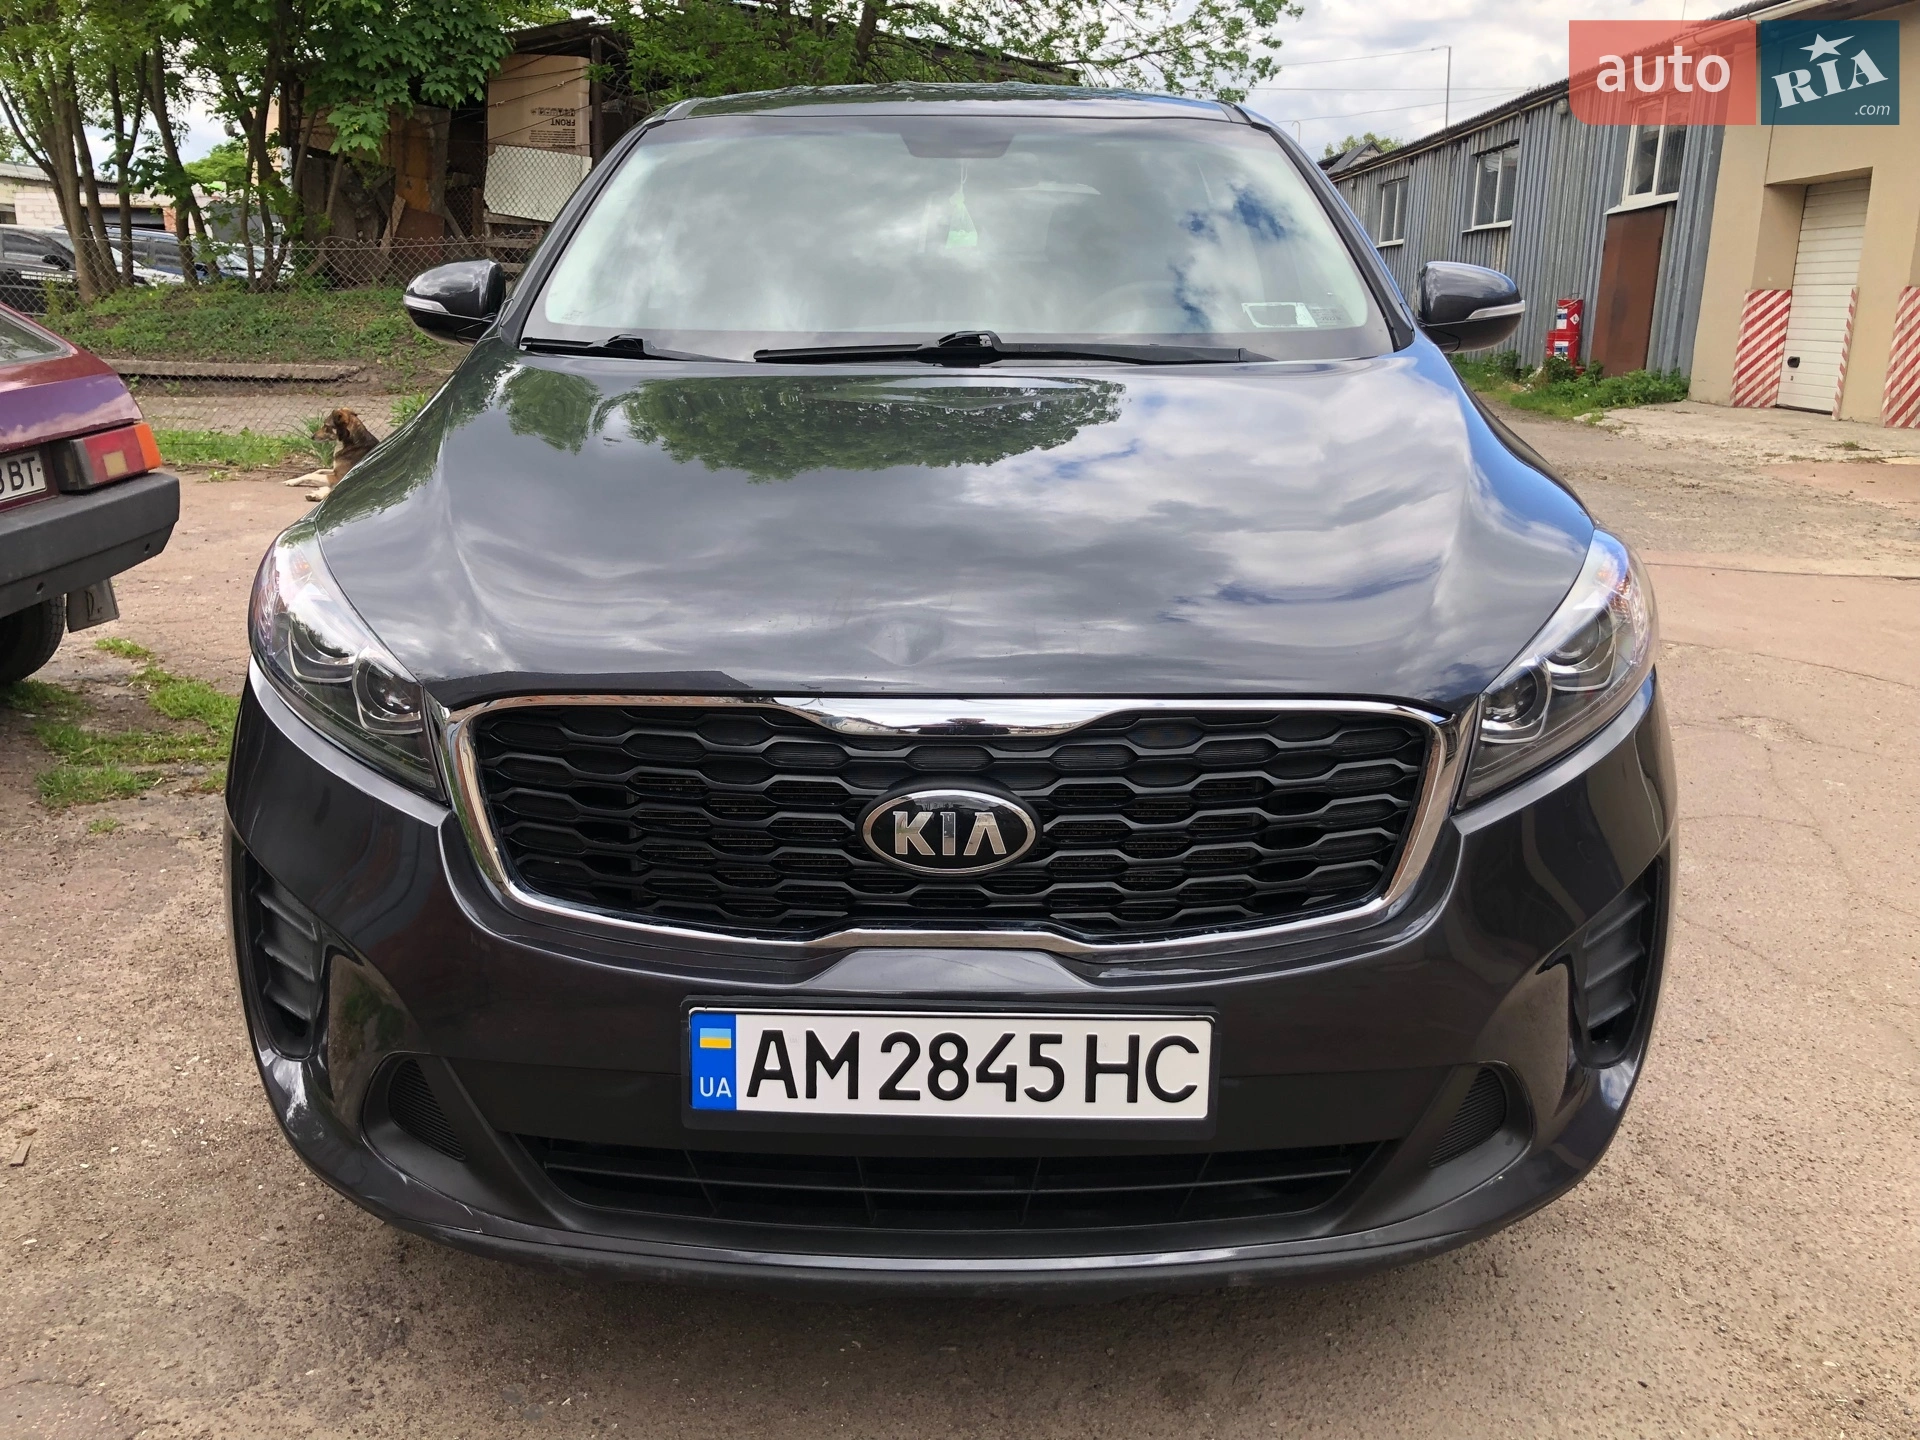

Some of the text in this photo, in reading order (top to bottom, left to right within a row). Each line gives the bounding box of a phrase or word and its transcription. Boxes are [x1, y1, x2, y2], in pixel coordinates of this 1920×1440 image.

[550, 118, 575, 127] FRONT
[7, 456, 36, 492] BT
[892, 811, 1007, 856] KIA
[746, 1029, 1200, 1103] AM 2845 HC
[699, 1076, 733, 1098] UA
